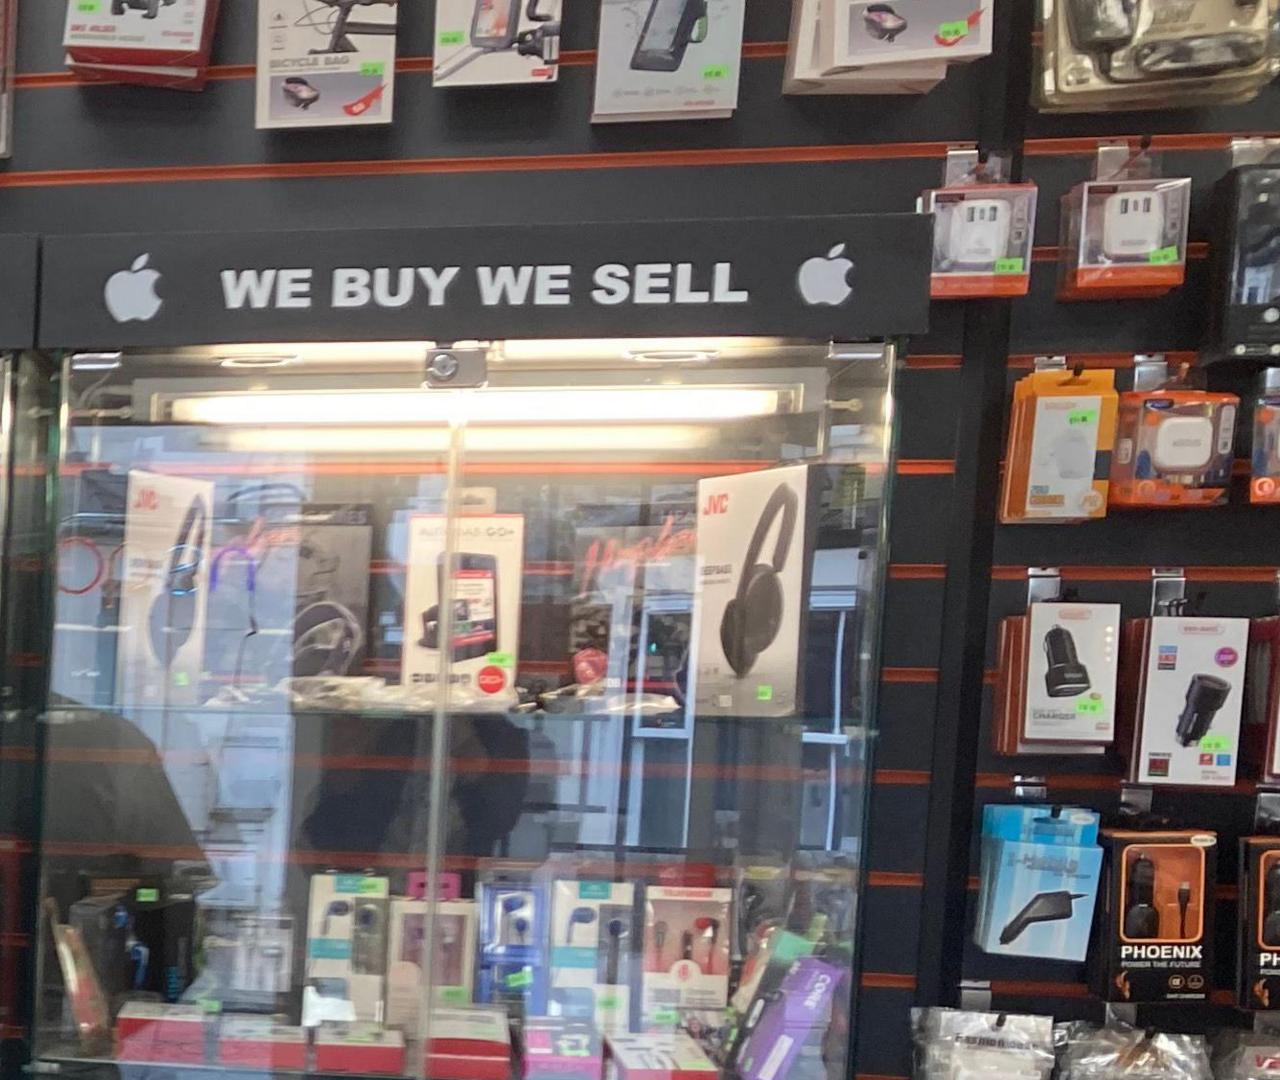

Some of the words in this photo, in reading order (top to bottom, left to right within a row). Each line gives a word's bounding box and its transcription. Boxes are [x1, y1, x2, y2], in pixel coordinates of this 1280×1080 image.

[269, 59, 319, 68] BICYCLE
[323, 57, 351, 67] BAG
[220, 268, 312, 308] WE
[331, 267, 461, 307] BUY
[475, 265, 572, 306] WE
[591, 262, 748, 305] SELL
[703, 494, 729, 515] JVC
[1120, 945, 1203, 958] PHOENIX
